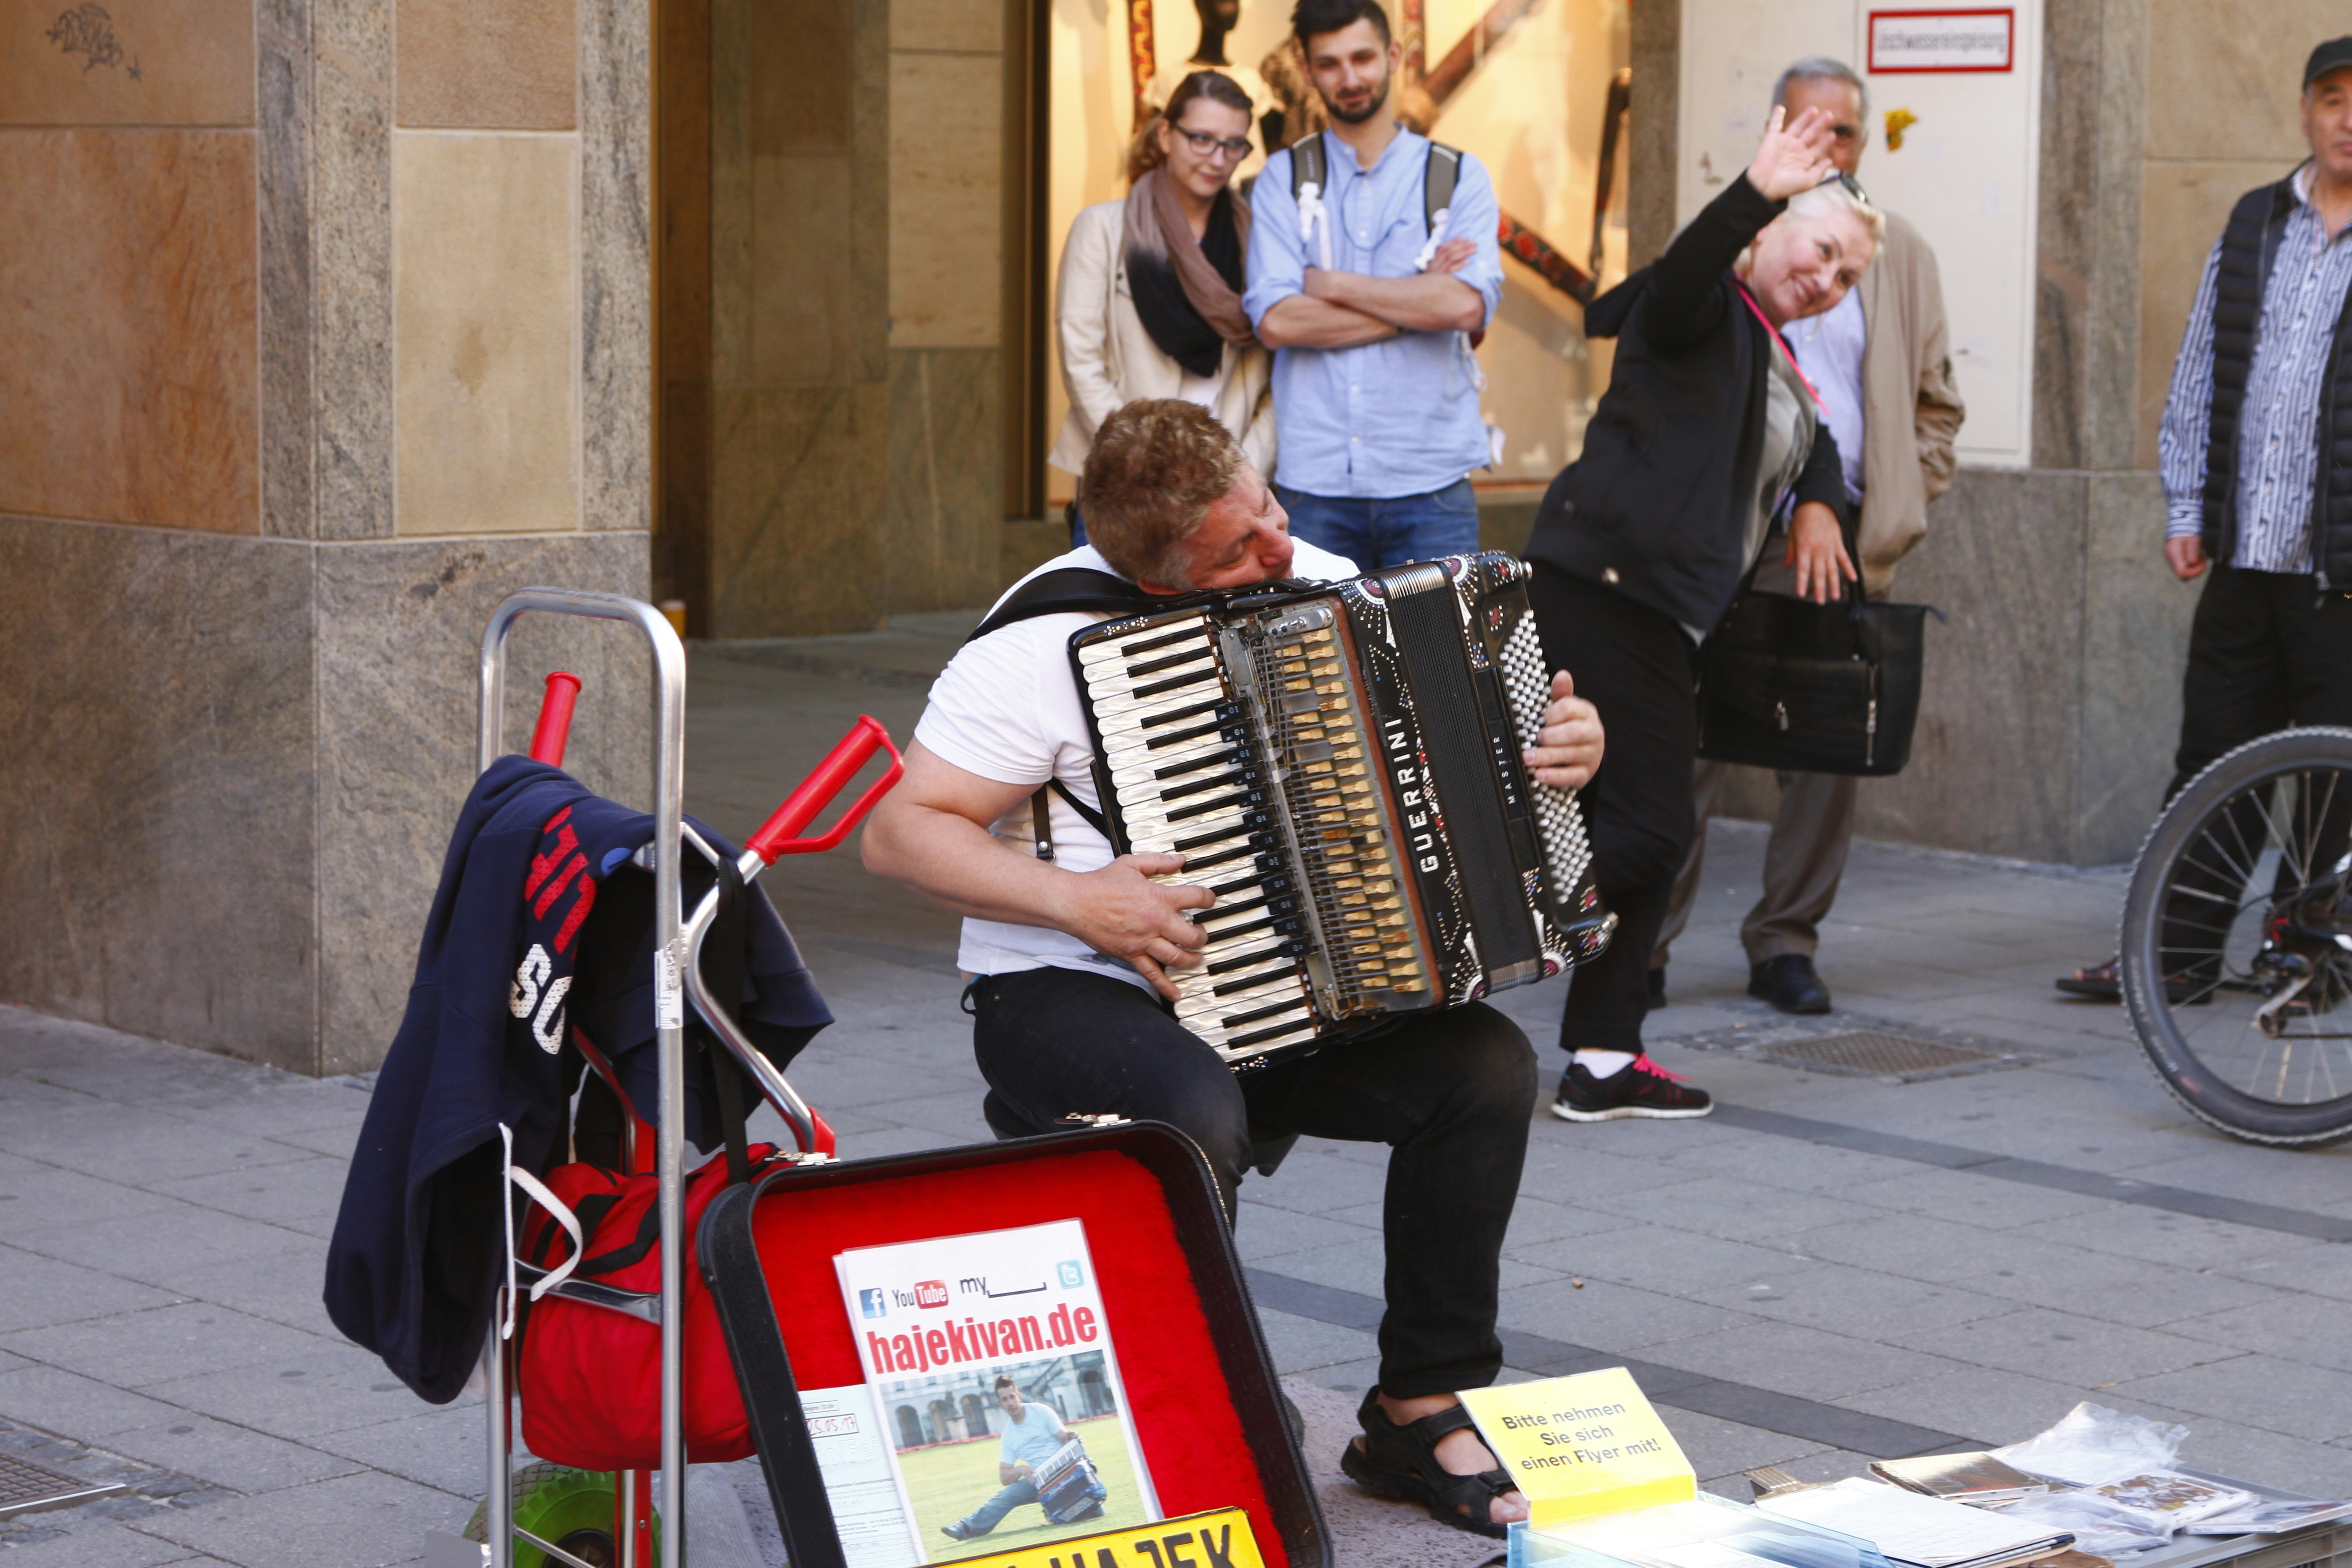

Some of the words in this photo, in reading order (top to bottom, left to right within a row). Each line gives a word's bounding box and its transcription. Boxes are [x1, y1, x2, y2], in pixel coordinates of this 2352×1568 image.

[1493, 736, 1516, 804] MASTER
[1384, 719, 1439, 873] GUERRINI
[866, 1303, 1097, 1373] hajekivan.de
[1502, 1412, 1548, 1429] Bitte
[1552, 1402, 1626, 1423] nehmen
[1540, 1431, 1571, 1446] Sie
[1576, 1425, 1614, 1441] sich
[1521, 1456, 1571, 1470] einen
[1574, 1448, 1620, 1464] Flyer
[1625, 1438, 1662, 1456] mit!
[1049, 1524, 1236, 1568] JEK
